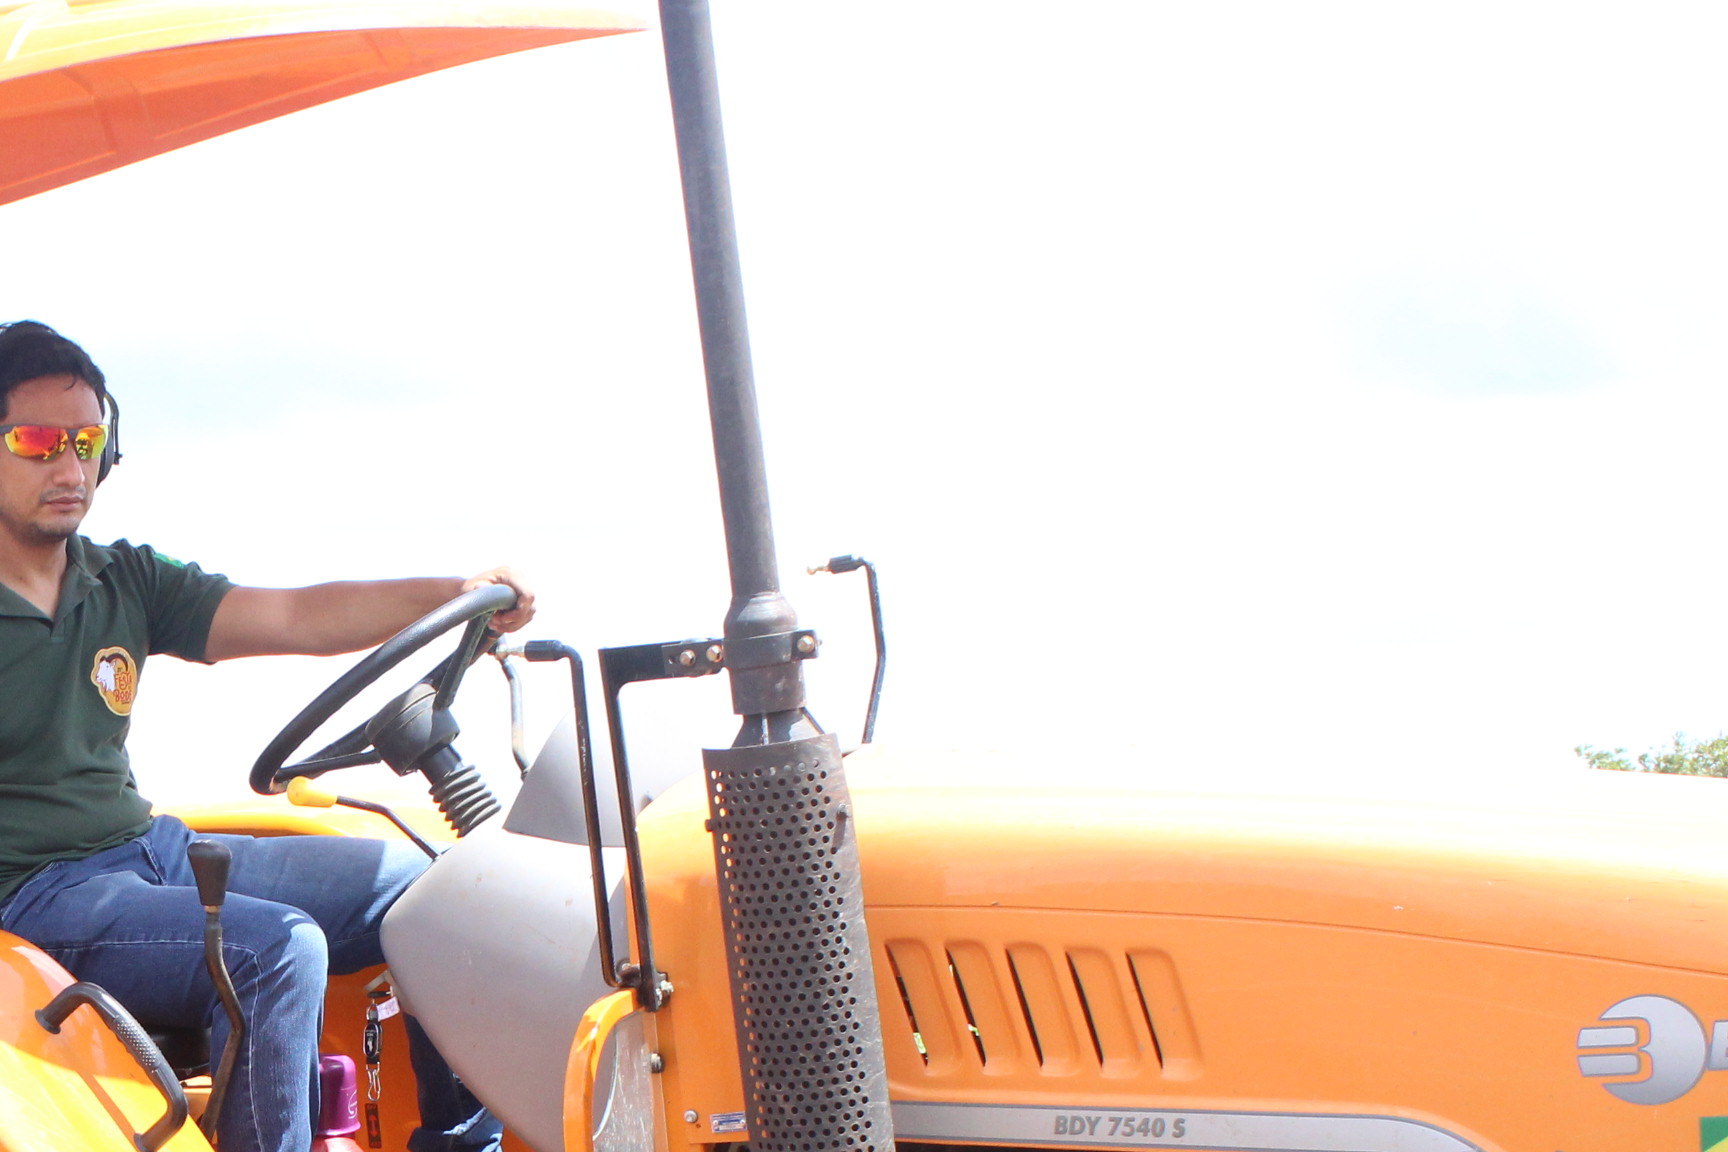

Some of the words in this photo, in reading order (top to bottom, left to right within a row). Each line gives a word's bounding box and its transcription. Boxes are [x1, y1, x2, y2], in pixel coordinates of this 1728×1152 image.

[1054, 1115, 1101, 1136] BDY
[1108, 1116, 1165, 1138] 7540
[1171, 1118, 1186, 1138] S
